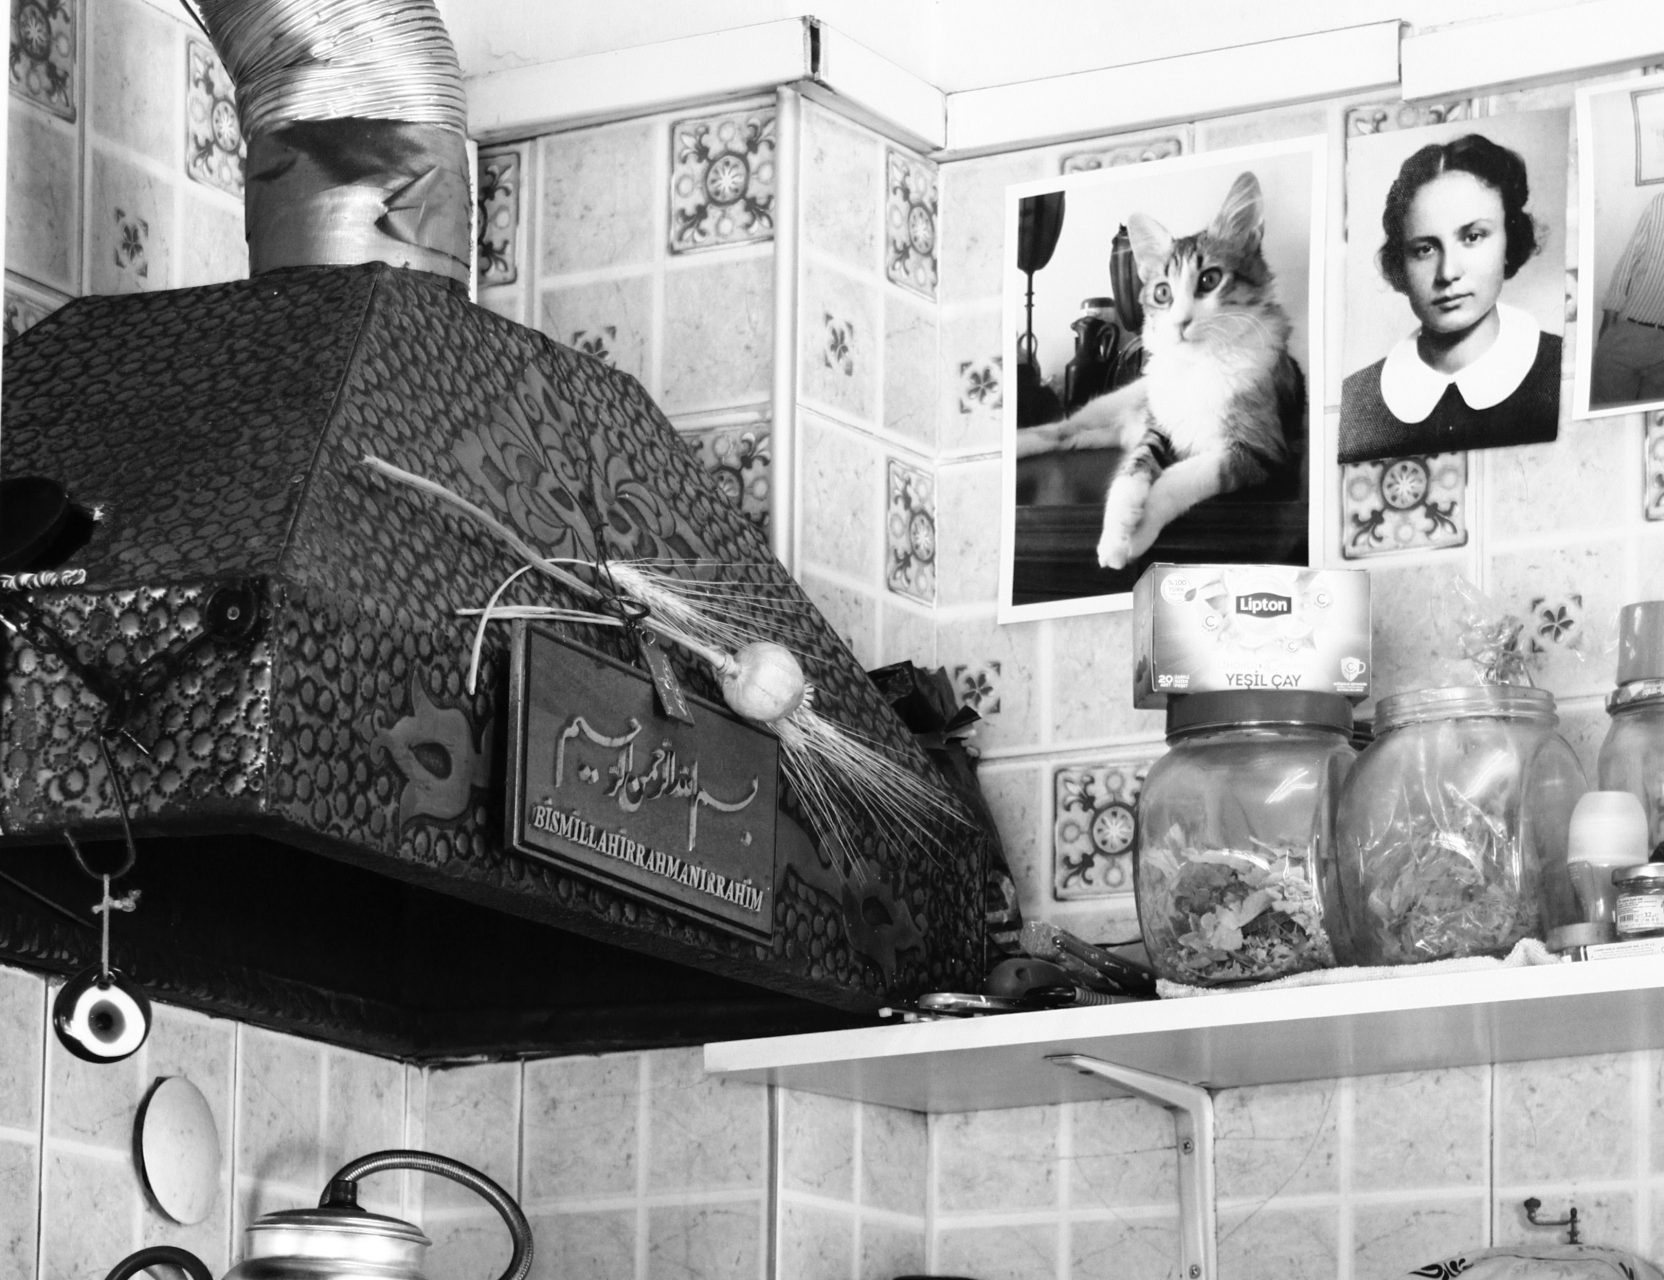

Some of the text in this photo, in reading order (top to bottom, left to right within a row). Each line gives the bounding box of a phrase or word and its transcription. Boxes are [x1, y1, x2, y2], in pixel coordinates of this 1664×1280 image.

[1240, 597, 1288, 614] Lipton
[1226, 670, 1302, 689] YEŞİL ÇAY
